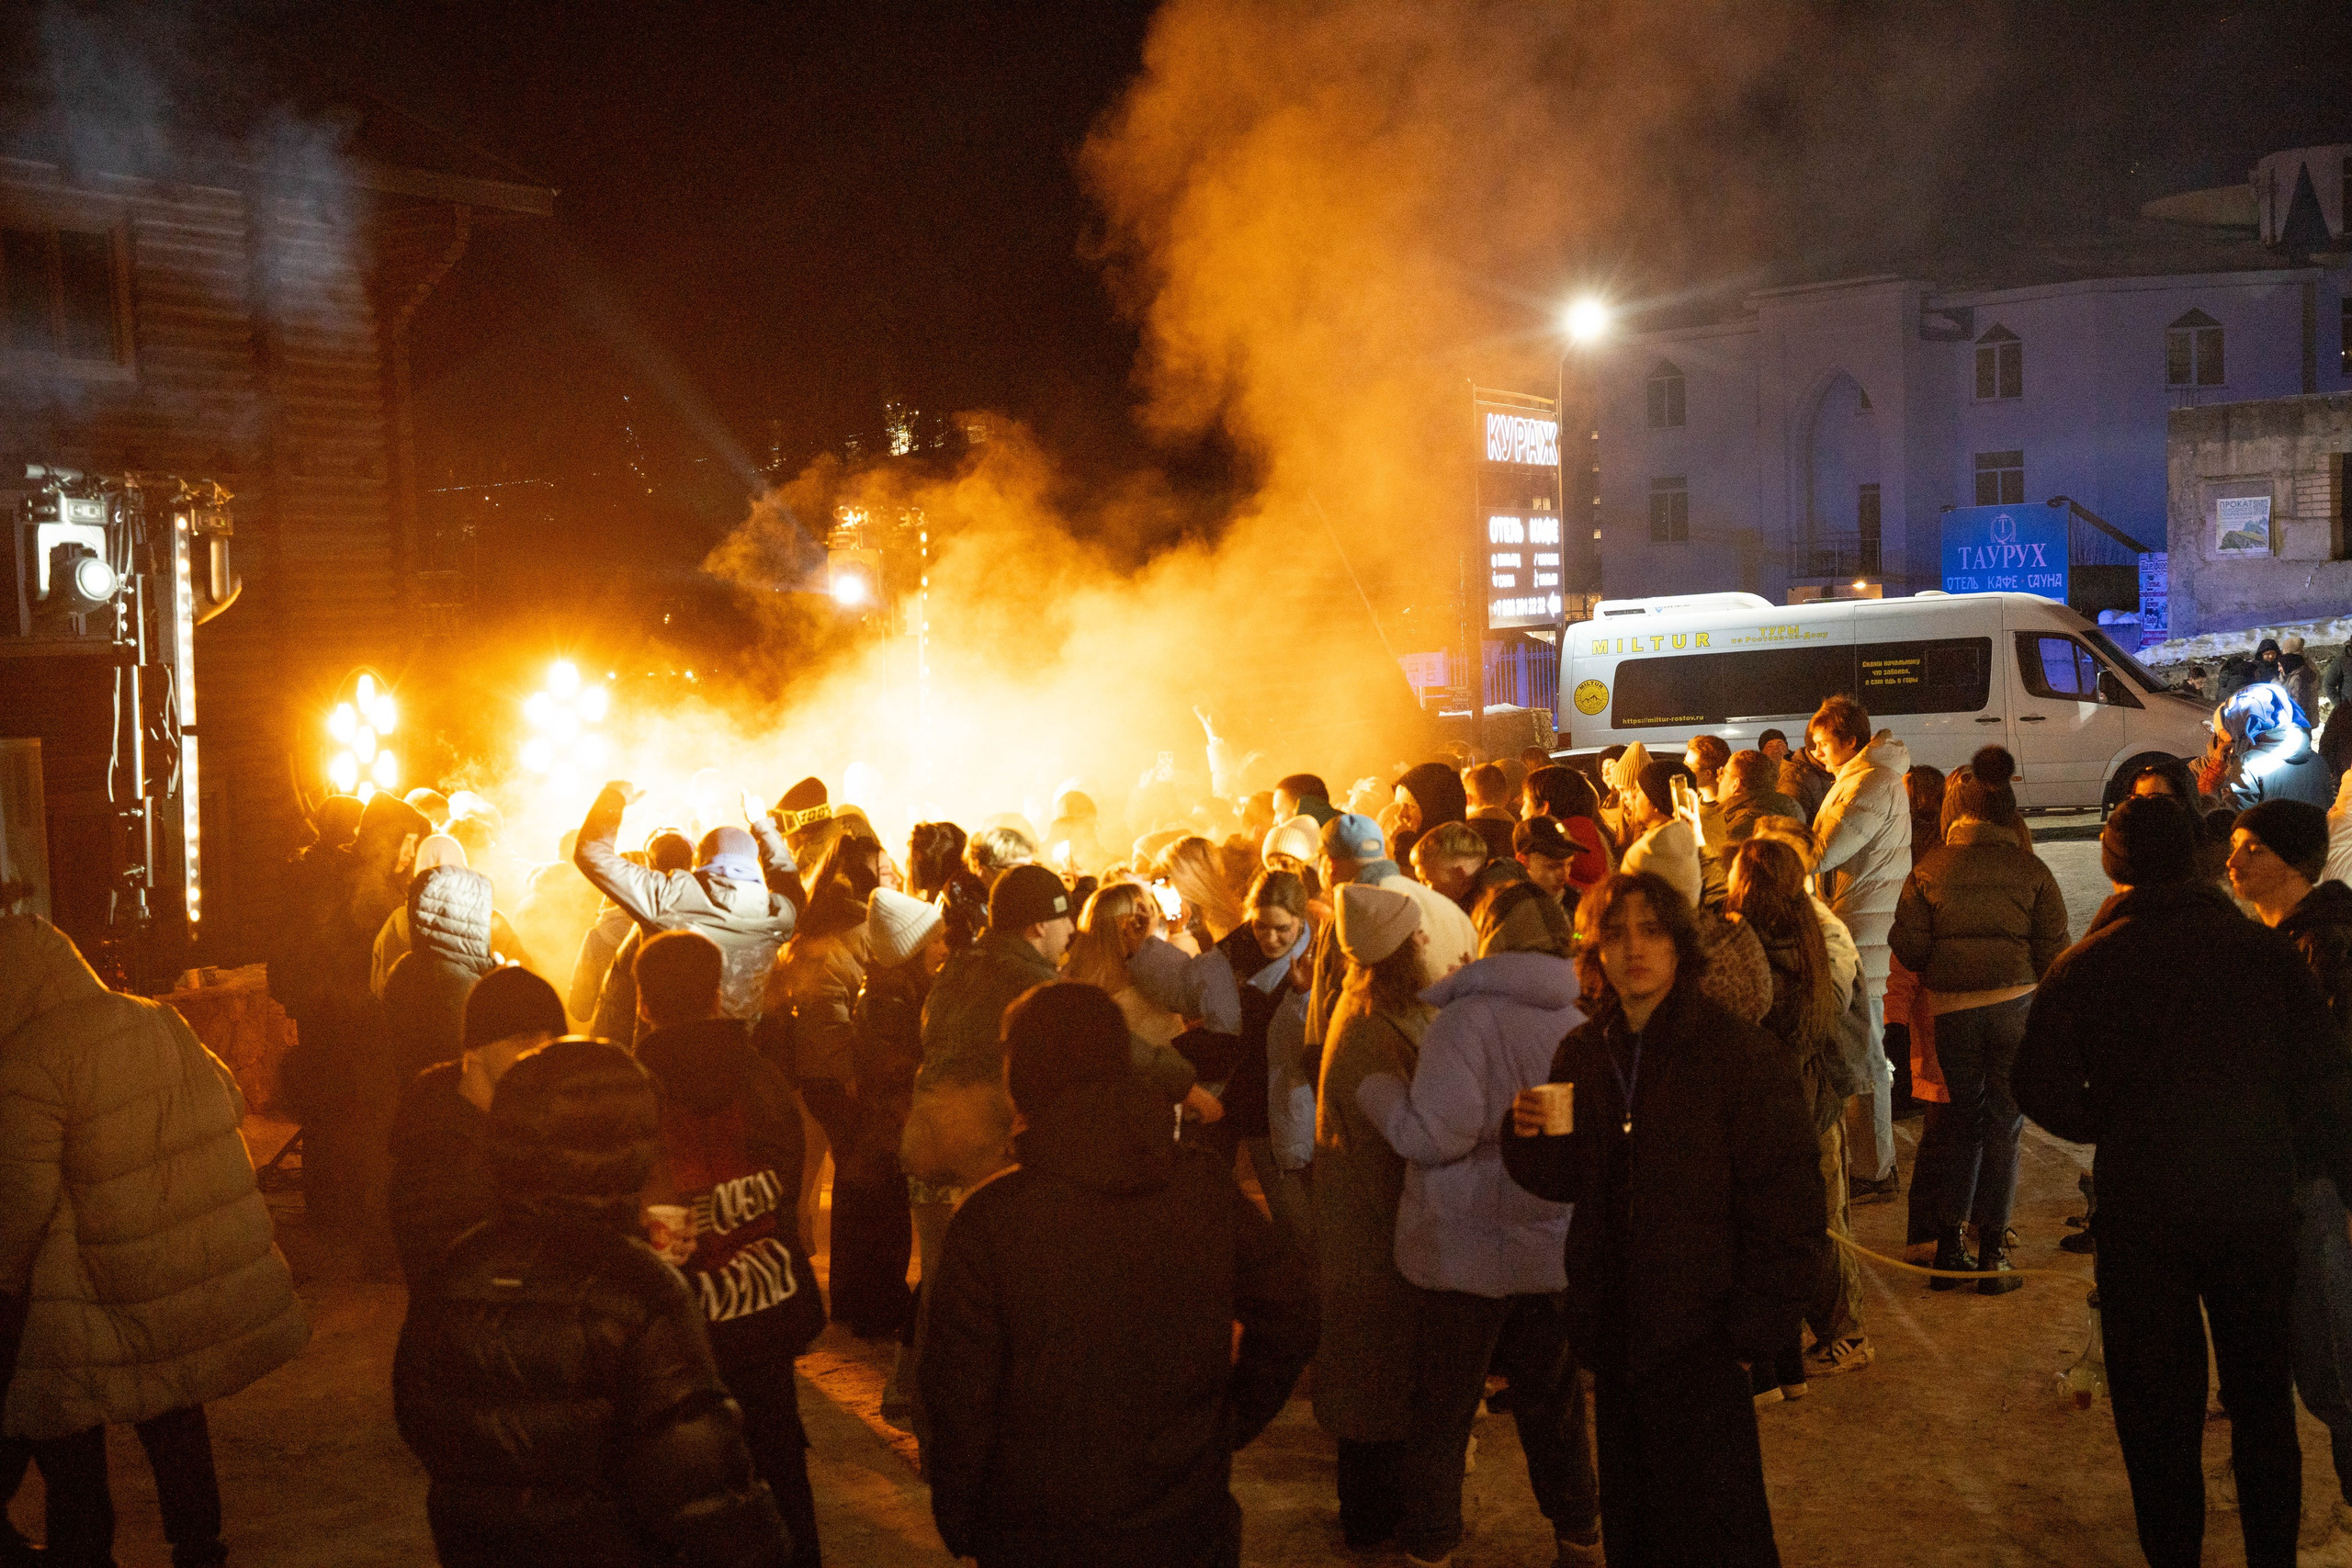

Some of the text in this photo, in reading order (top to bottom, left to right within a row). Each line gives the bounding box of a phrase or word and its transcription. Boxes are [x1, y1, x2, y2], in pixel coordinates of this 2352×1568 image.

[1487, 412, 1558, 466] КУРАЖ
[2220, 500, 2253, 508] ПРОКАТ
[1488, 515, 1559, 545] ОТЕЛЬ КАФЕ
[1958, 543, 2047, 570] ТАУРУХ
[1947, 573, 2063, 590] ОТЕЛЬ КАФЕ САУНА
[1758, 625, 1799, 637] ТУРЫ
[1592, 632, 1710, 655] MILTUR
[1883, 659, 1920, 667] начальнику
[1578, 681, 1604, 691] MILTUR
[1623, 715, 1704, 725] https://miltur-rostov.ru
